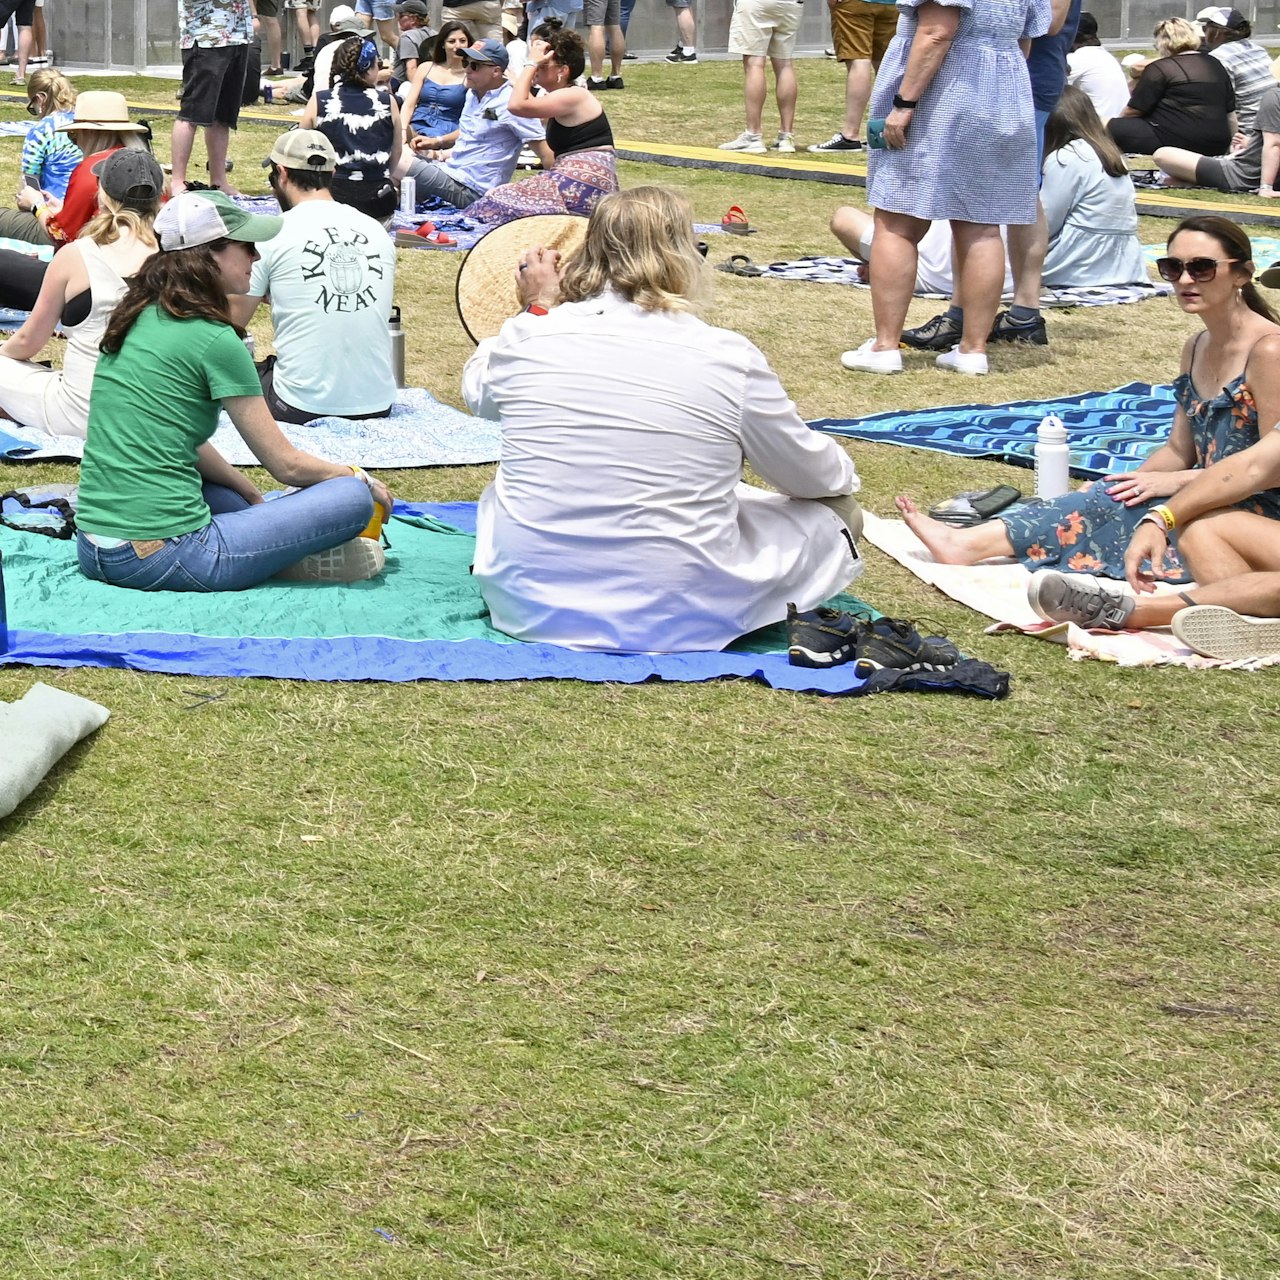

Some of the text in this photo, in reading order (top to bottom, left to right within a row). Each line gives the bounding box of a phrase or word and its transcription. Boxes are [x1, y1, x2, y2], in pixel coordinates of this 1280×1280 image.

[300, 227, 383, 282] KEEP IT
[314, 284, 378, 314] NEAT
